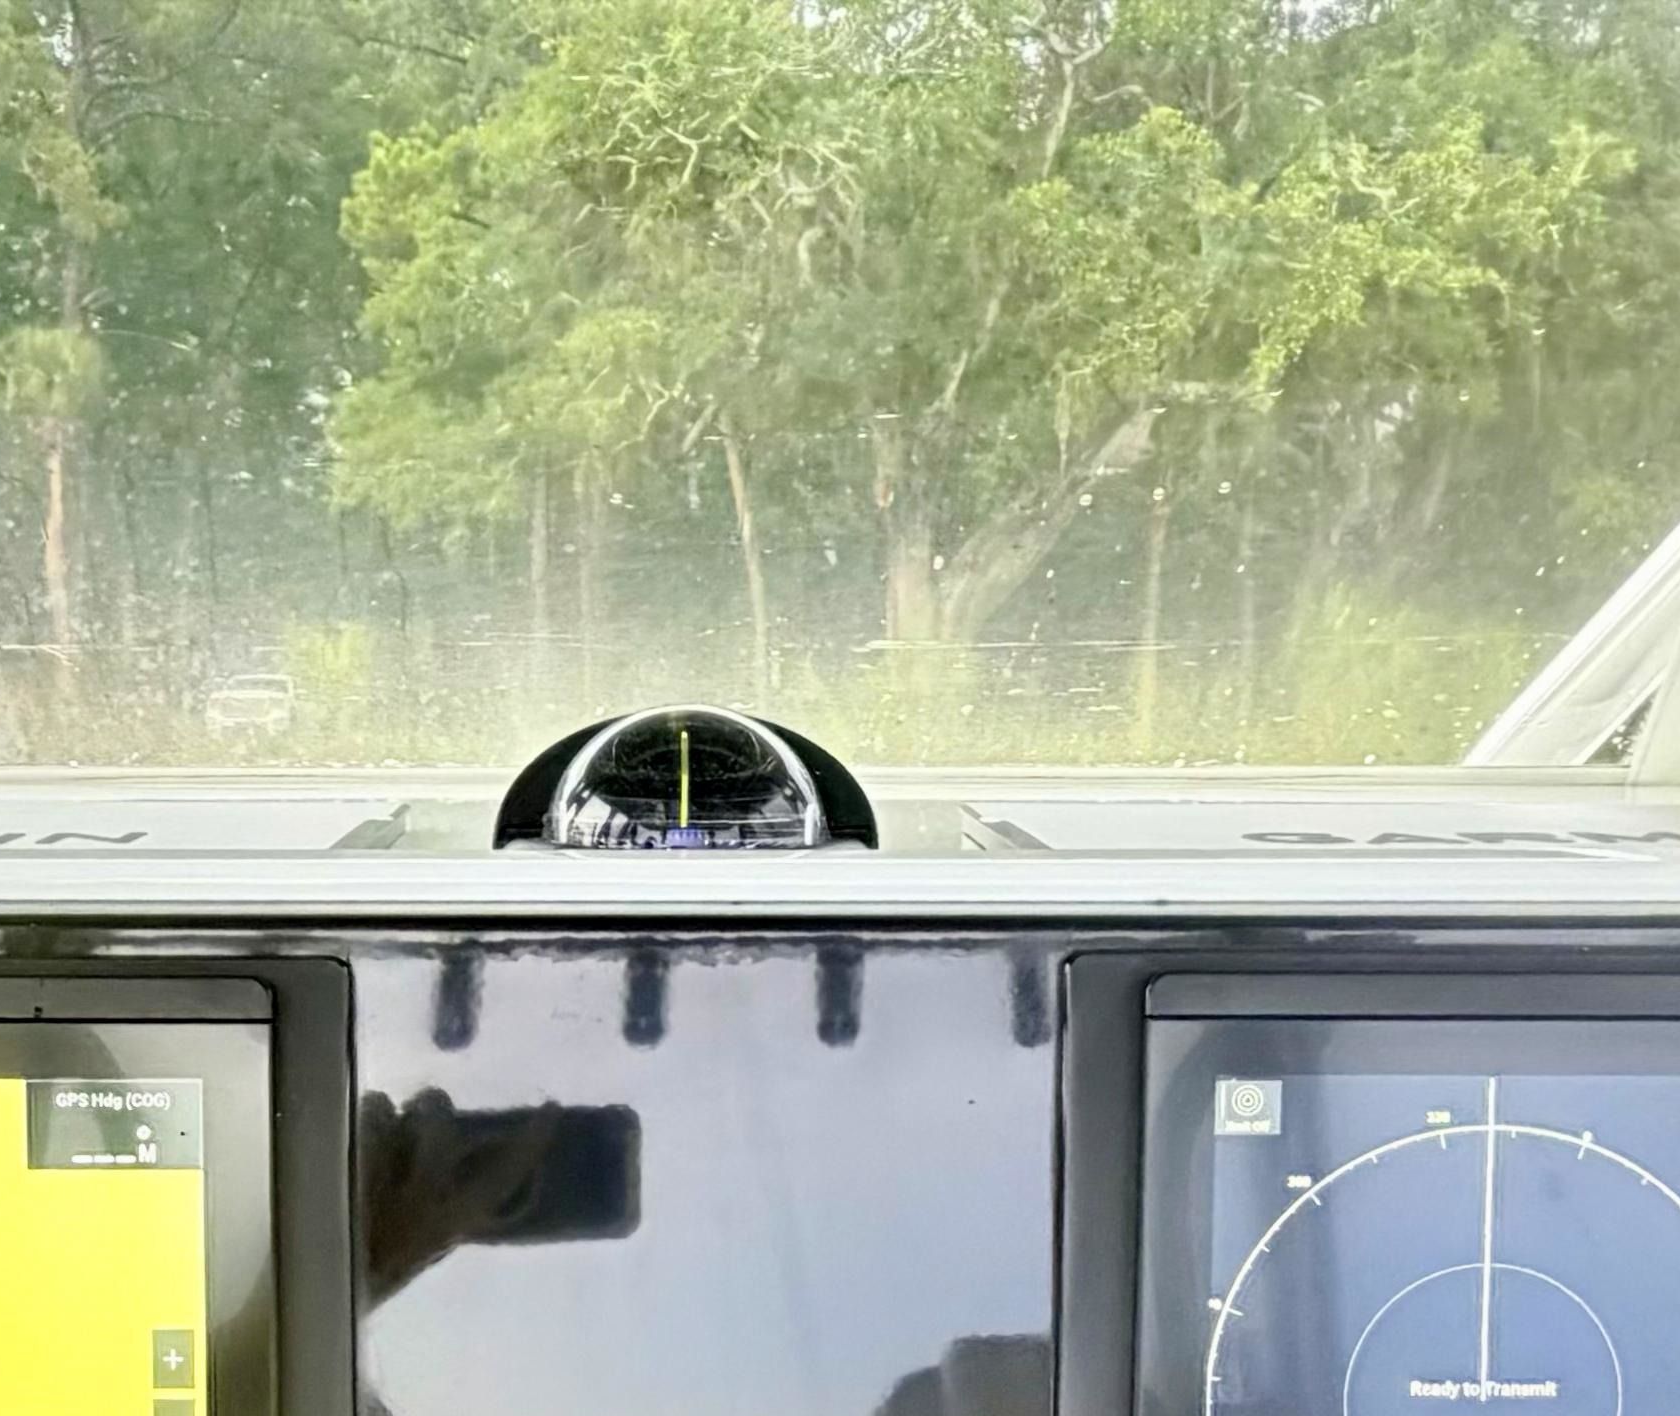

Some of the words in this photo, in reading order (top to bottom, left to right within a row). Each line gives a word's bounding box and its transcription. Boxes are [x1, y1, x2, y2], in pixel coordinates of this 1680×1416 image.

[55, 1092, 90, 1108] GPS
[92, 1092, 123, 1111] Hdg
[126, 1091, 171, 1111] (COG)
[1409, 1379, 1460, 1401] Ready
[1462, 1381, 1481, 1398] to
[1485, 1379, 1557, 1398] Transmit
